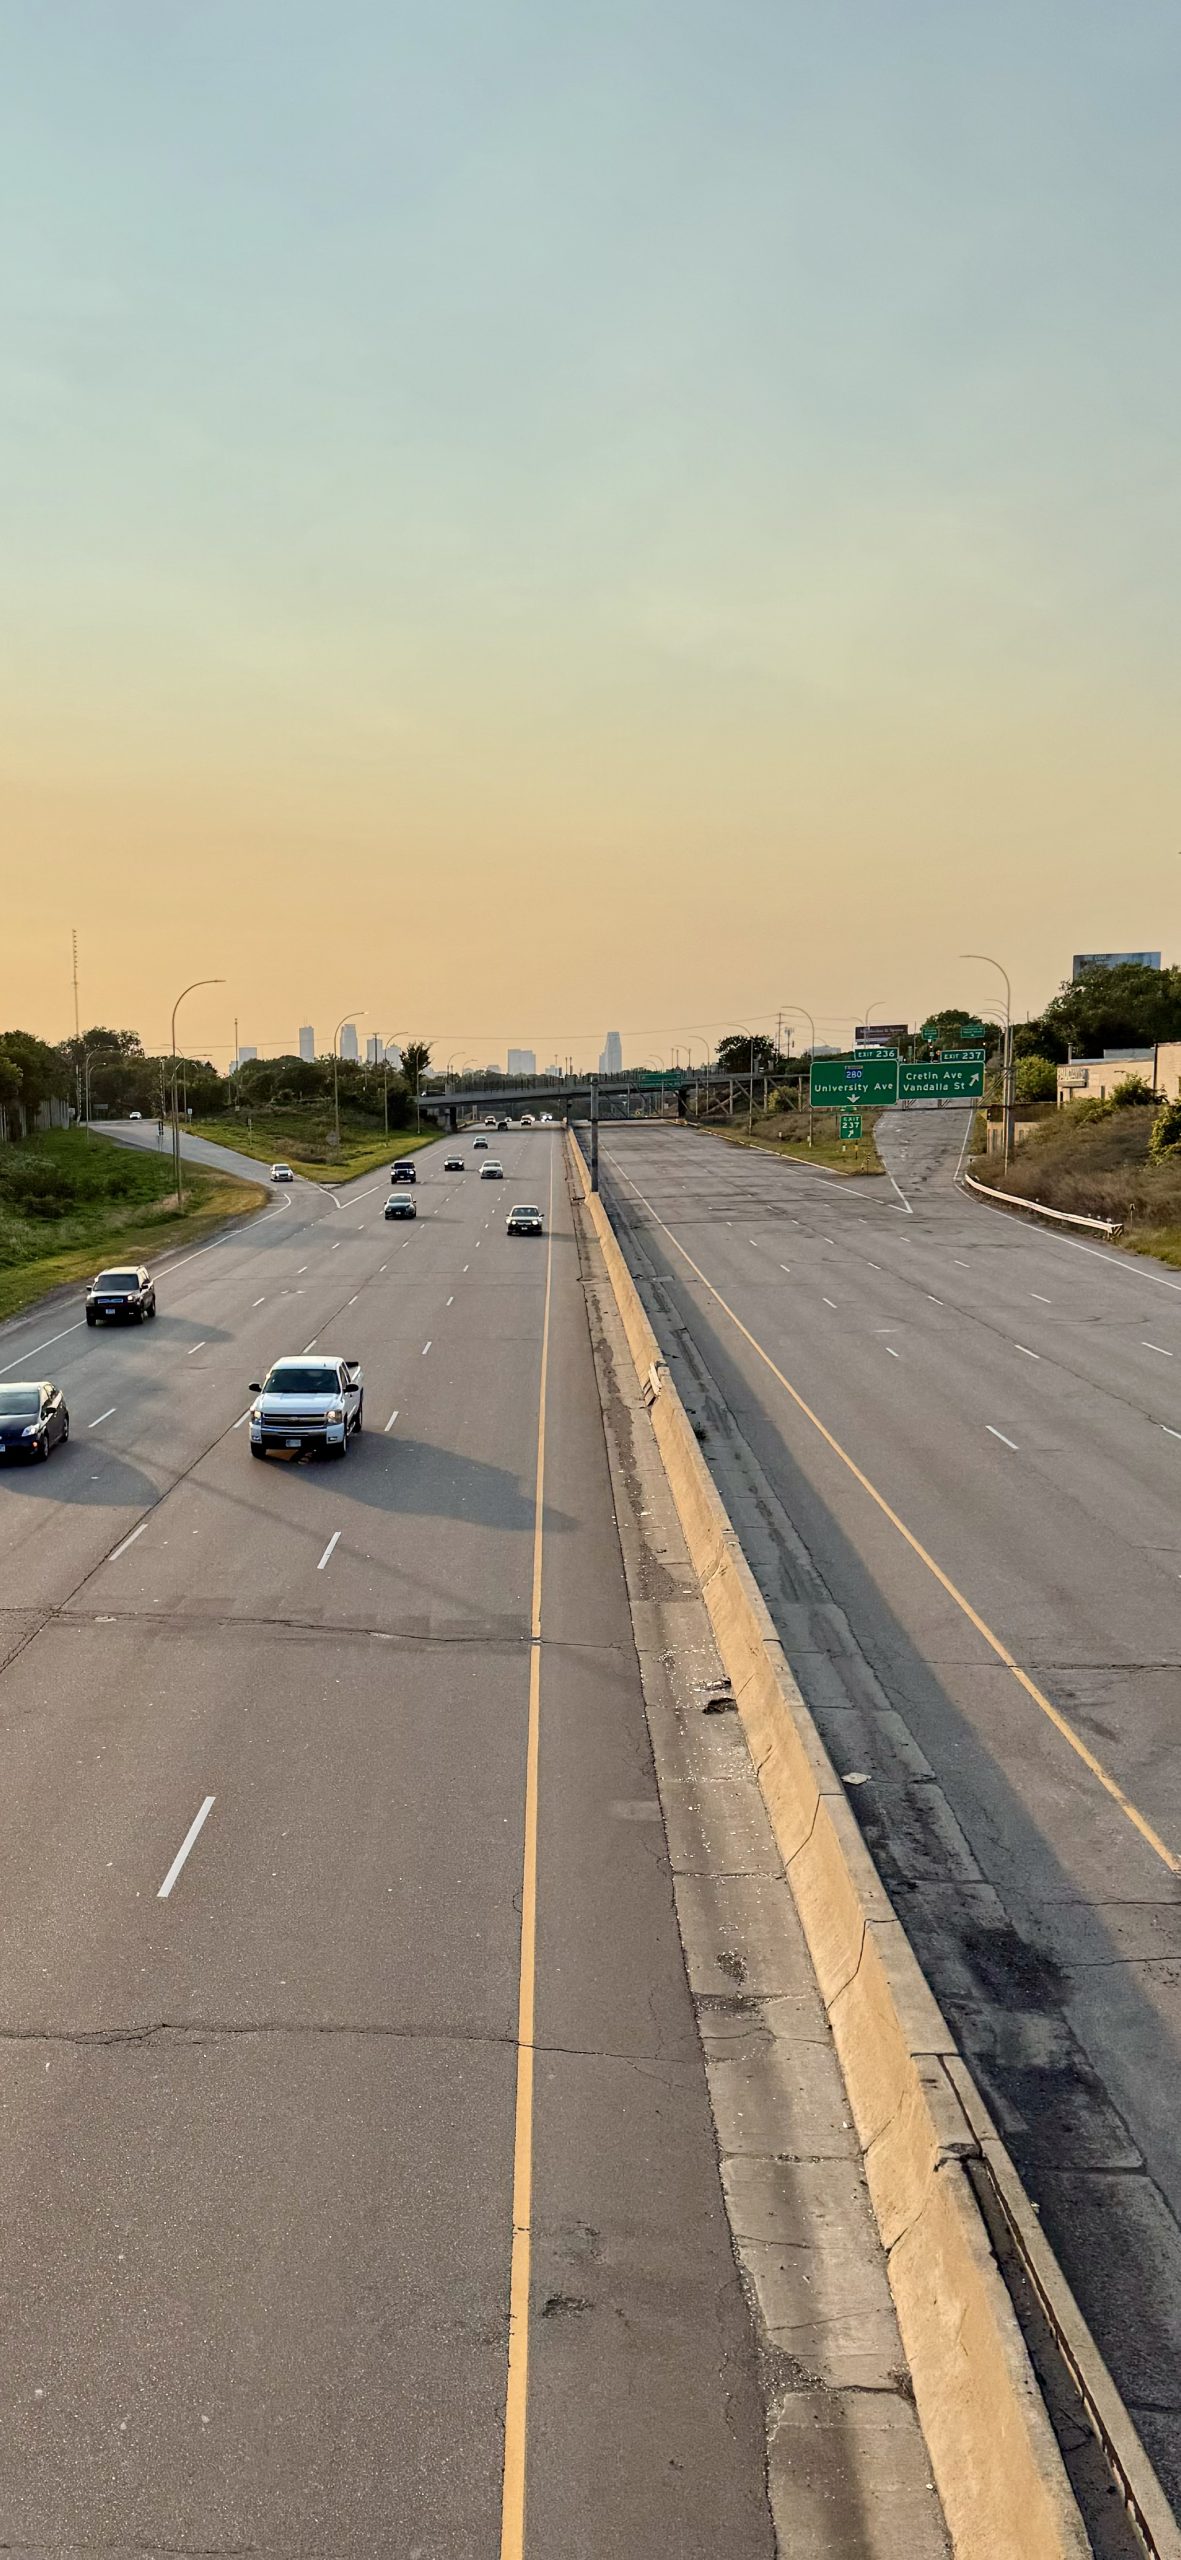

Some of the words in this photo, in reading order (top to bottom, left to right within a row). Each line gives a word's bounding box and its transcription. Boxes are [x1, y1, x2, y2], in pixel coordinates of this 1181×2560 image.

[876, 1050, 895, 1058] 236
[962, 1052, 981, 1060] 237
[846, 1070, 862, 1079] 280
[905, 1072, 938, 1080] Cretin
[943, 1071, 963, 1079] Ave
[814, 1083, 869, 1093] University
[903, 1083, 949, 1091] Vandalia
[954, 1082, 965, 1090] St
